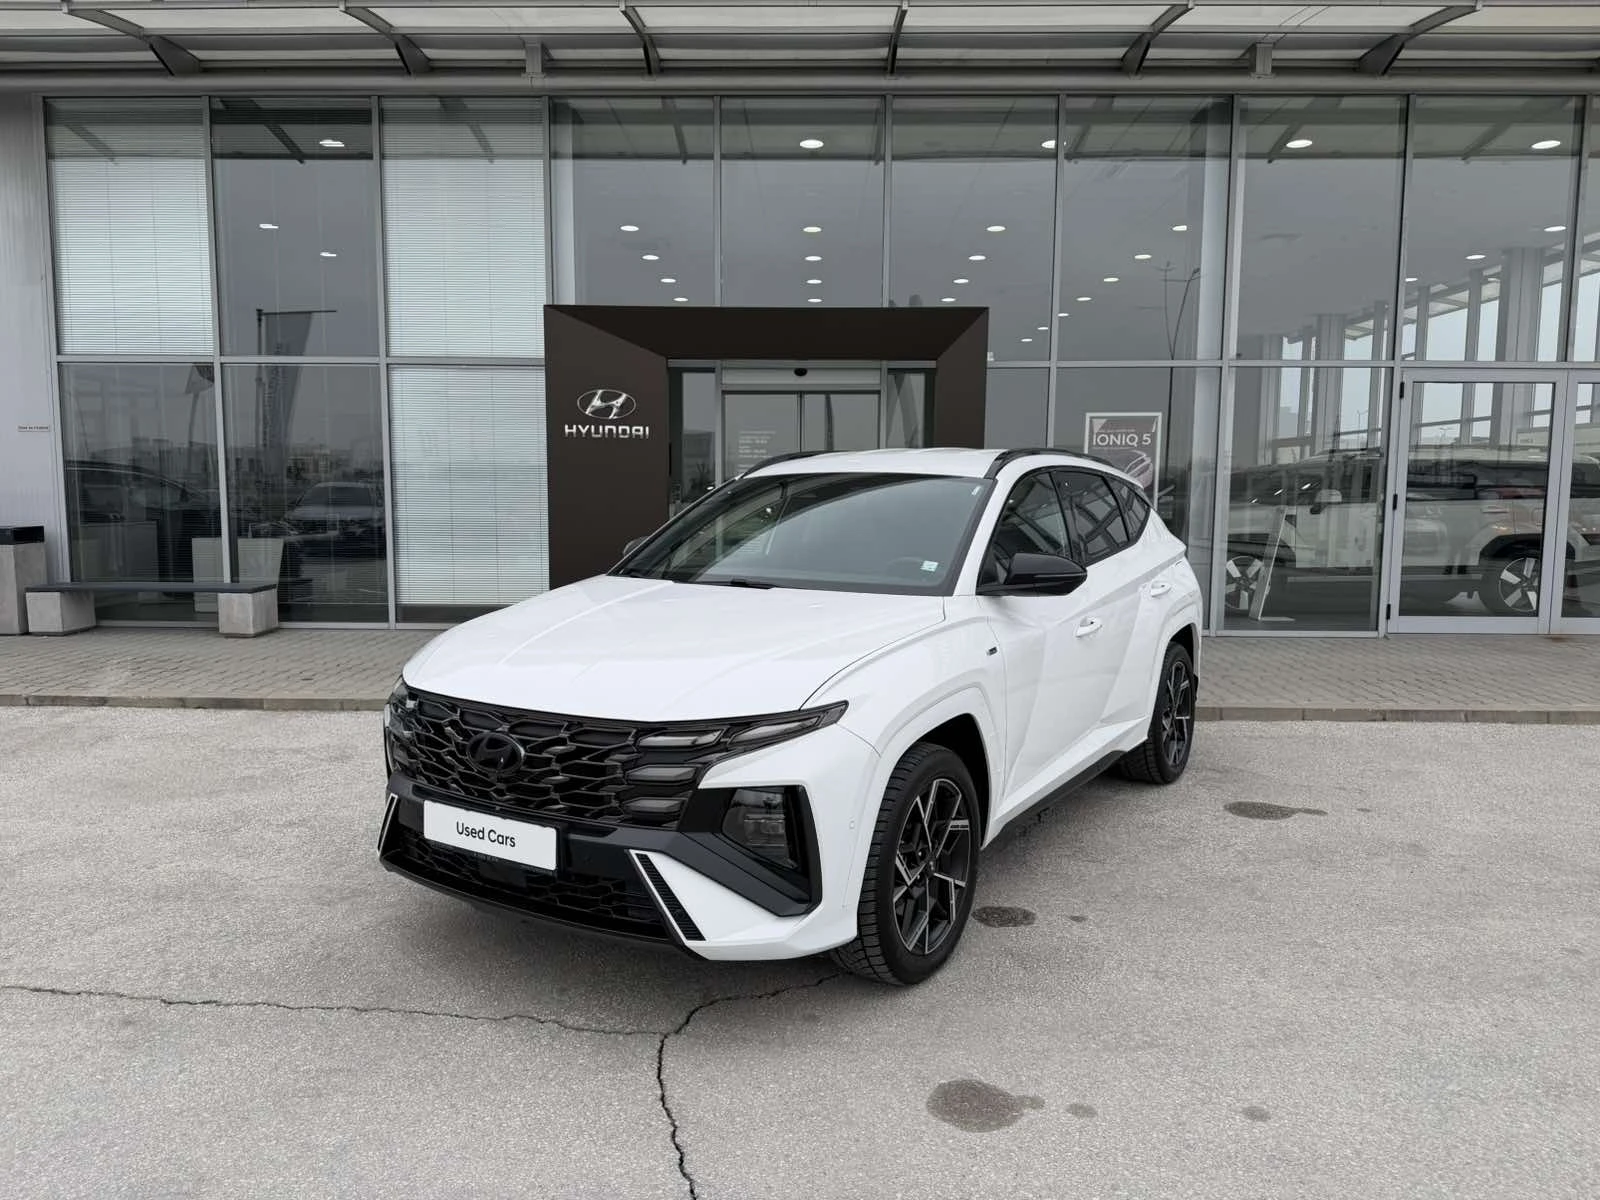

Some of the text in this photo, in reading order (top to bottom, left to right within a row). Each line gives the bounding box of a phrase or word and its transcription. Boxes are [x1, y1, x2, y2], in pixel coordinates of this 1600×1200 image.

[565, 424, 649, 439] HYUNDAI
[1093, 433, 1151, 447] IONIQ 5
[456, 821, 516, 848] Used Cars
